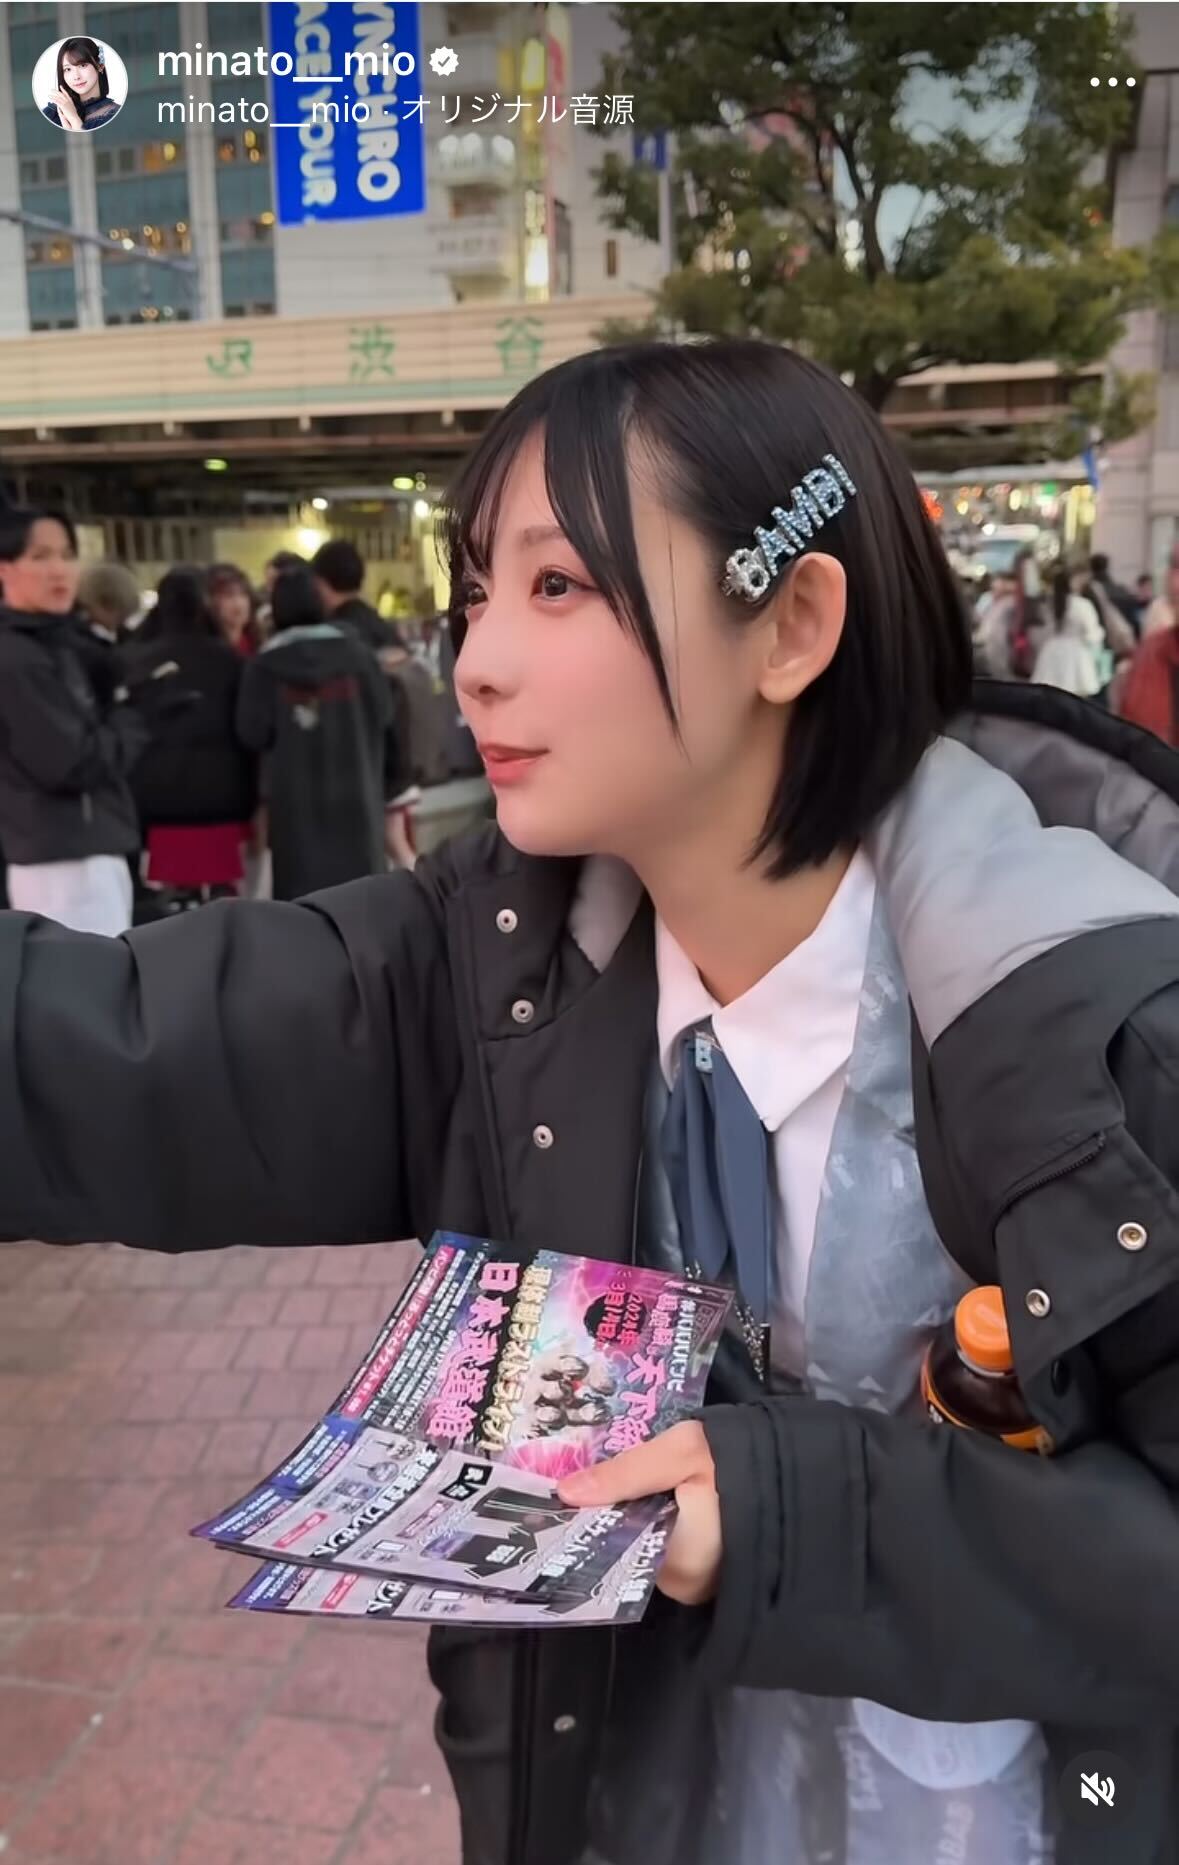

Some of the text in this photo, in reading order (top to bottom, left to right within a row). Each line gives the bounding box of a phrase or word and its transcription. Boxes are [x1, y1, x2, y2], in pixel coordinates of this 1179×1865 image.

[297, 86, 337, 207] YOUR
[206, 338, 253, 378] JR
[426, 1261, 521, 1443] 日本武道館
[617, 1292, 643, 1346] 2024年
